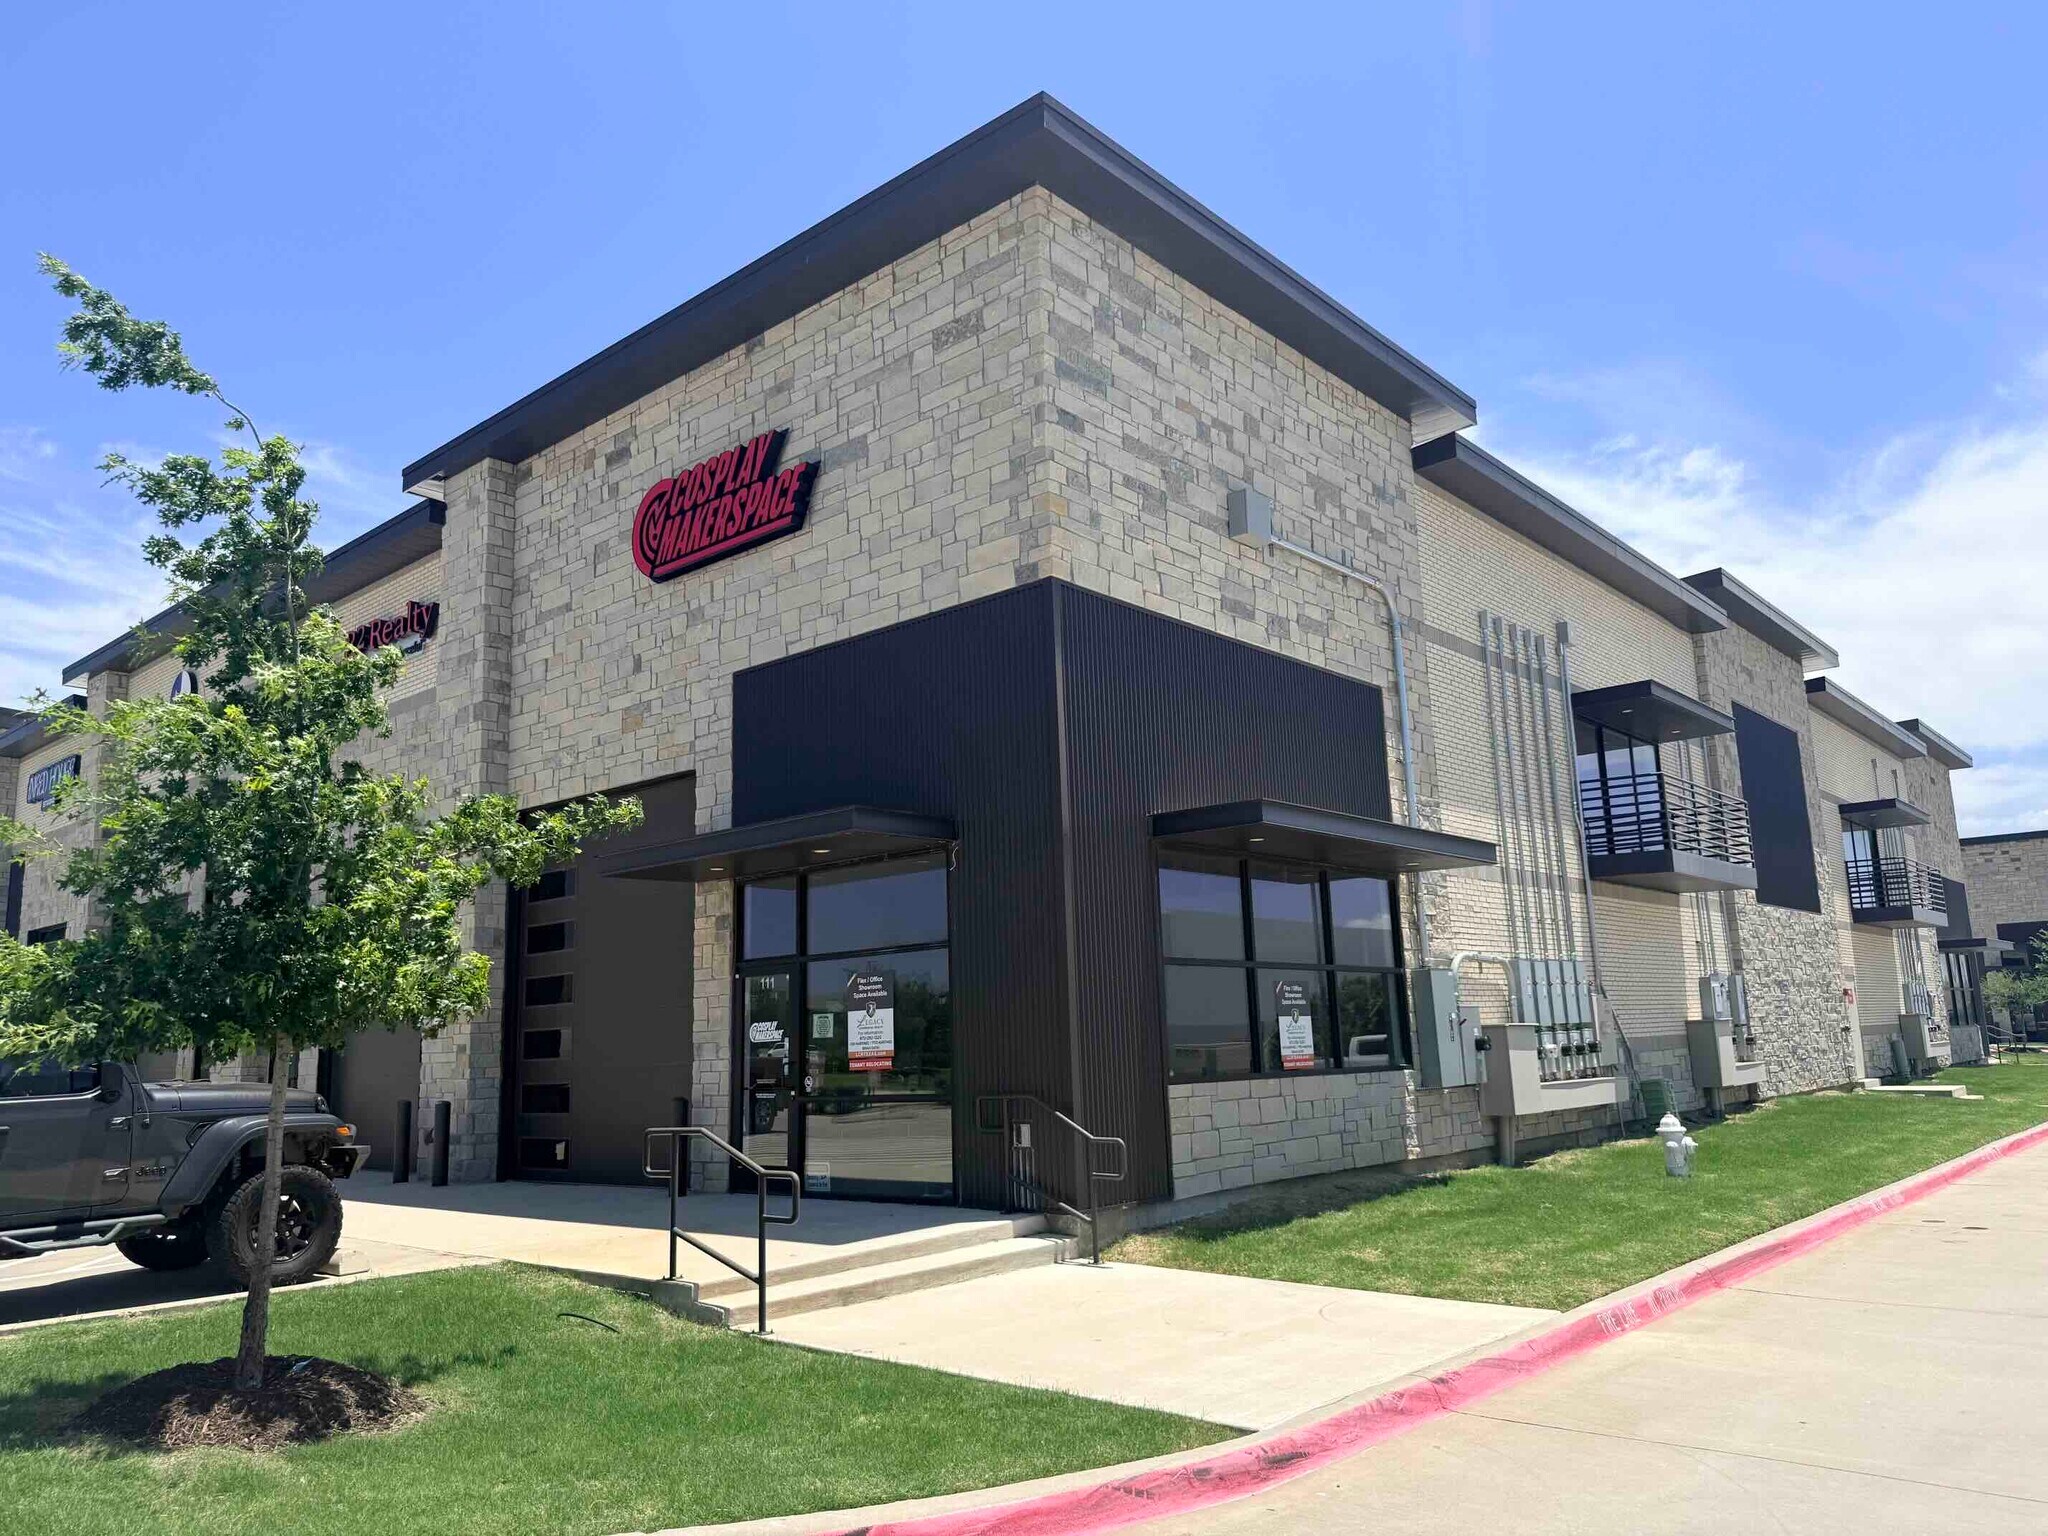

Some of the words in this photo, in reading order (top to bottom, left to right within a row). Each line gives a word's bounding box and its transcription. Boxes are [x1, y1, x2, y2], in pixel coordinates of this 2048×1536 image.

[668, 429, 779, 517] COSPLAY
[655, 461, 809, 565] MAKERSPACE
[369, 600, 437, 650] Realty
[760, 976, 775, 990] 111
[867, 990, 888, 998] Available
[870, 975, 883, 983] Office
